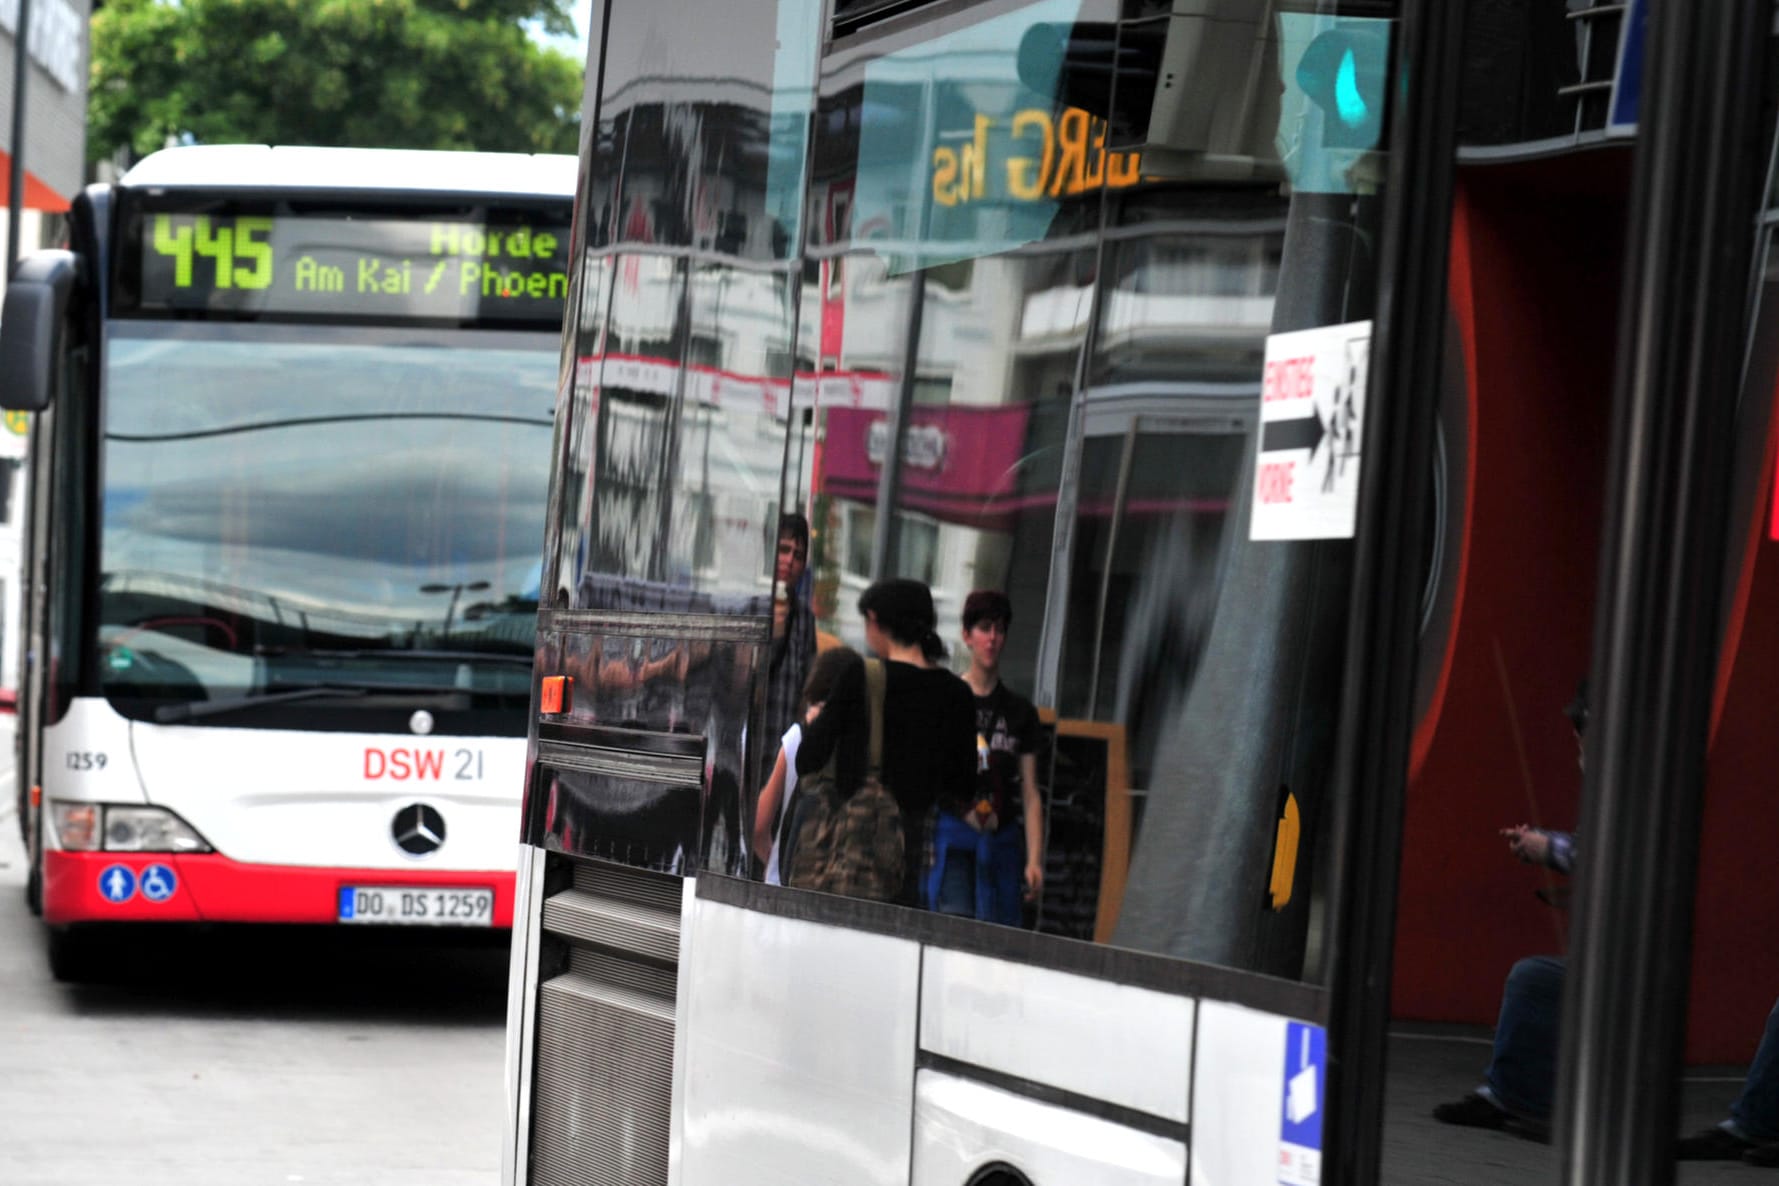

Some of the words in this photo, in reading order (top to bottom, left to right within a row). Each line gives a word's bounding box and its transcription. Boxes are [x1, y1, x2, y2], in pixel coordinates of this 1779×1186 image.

[153, 213, 273, 289] 445
[296, 255, 344, 292] Am
[357, 258, 411, 294] Kai
[423, 260, 446, 295] /
[66, 751, 109, 771] 1259
[363, 747, 445, 781] DSW
[356, 892, 384, 916] DO
[401, 893, 428, 917] DS
[434, 895, 489, 918] 1259
